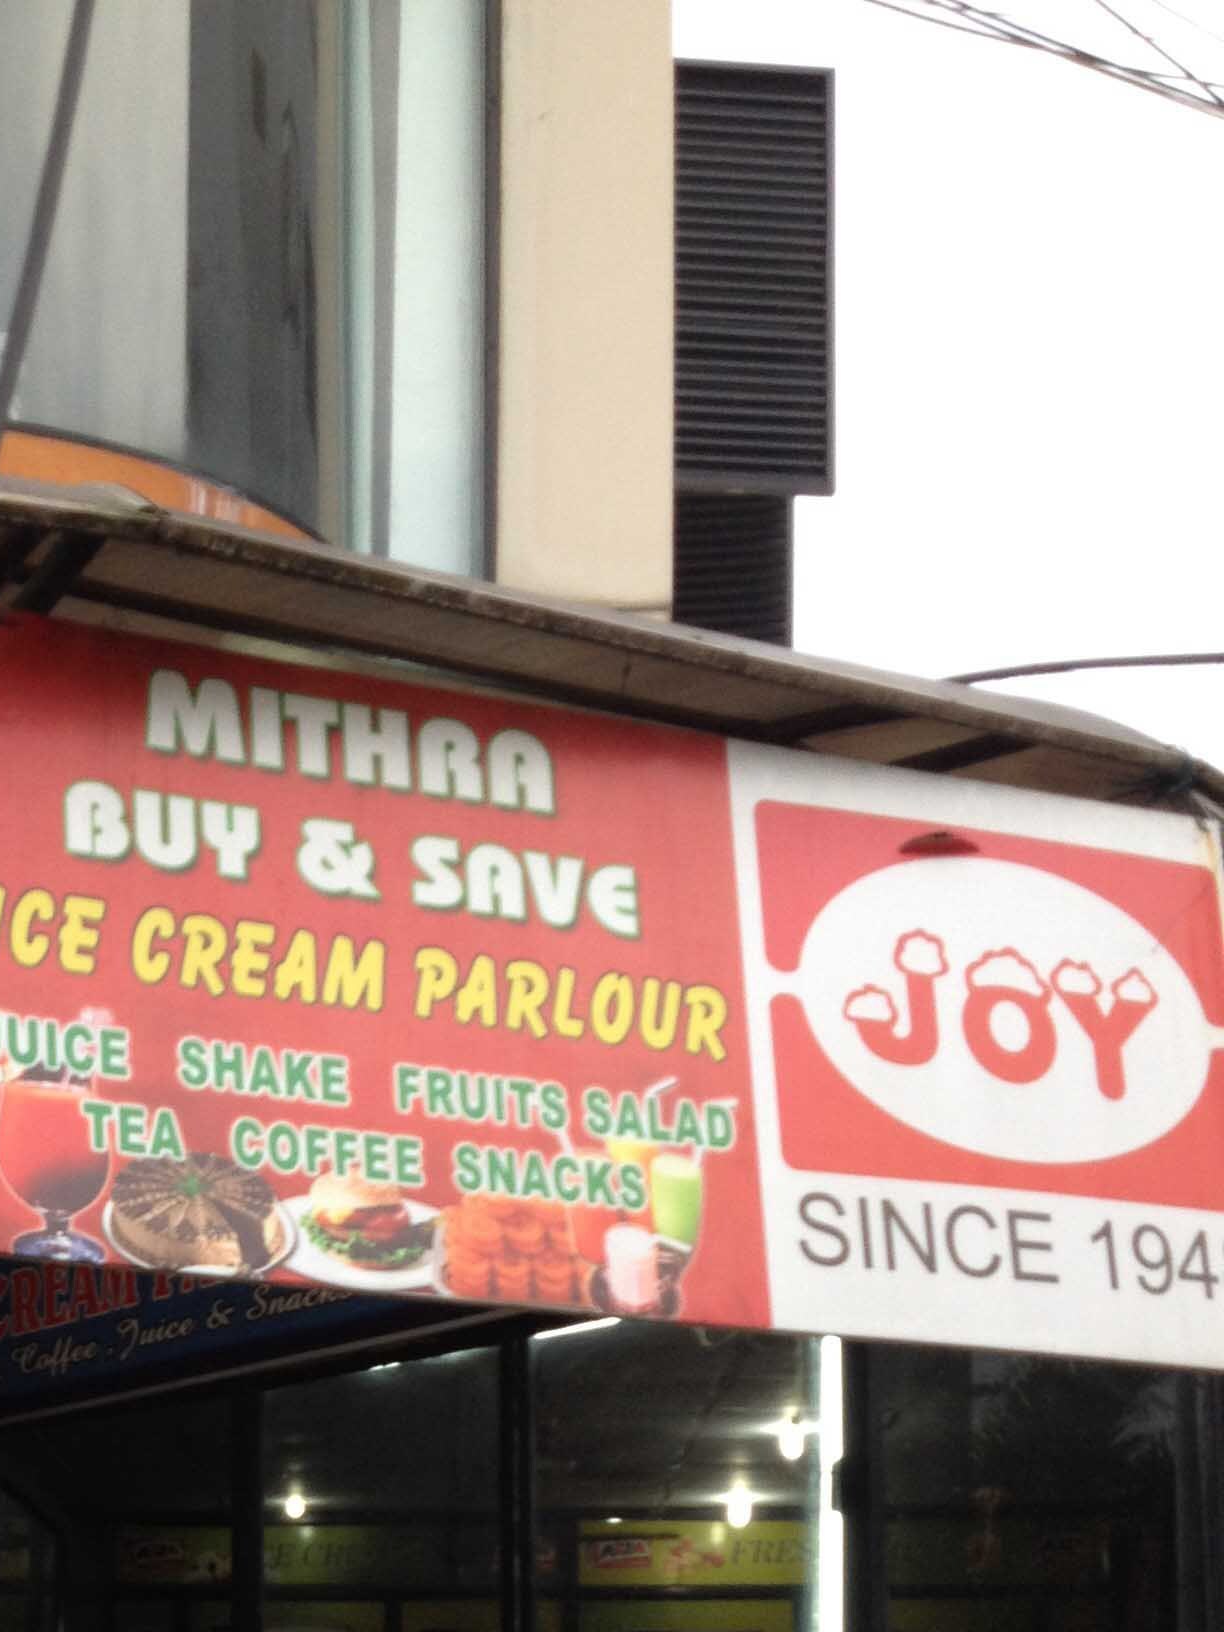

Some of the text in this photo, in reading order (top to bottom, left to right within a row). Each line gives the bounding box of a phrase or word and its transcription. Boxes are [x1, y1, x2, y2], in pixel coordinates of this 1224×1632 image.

[145, 668, 555, 814] MITHRA
[63, 779, 641, 939] BUY & SAVE
[132, 907, 385, 1012] CREAM
[414, 947, 729, 1061] PARLOUR
[843, 930, 1157, 1100] JOY
[83, 1100, 648, 1209] TEA COFFEE SNACKS
[180, 1038, 350, 1103] SHAKE
[395, 1065, 567, 1129] FRUITS
[585, 1087, 733, 1150] SALAD
[797, 1192, 1224, 1300] SINCE 194
